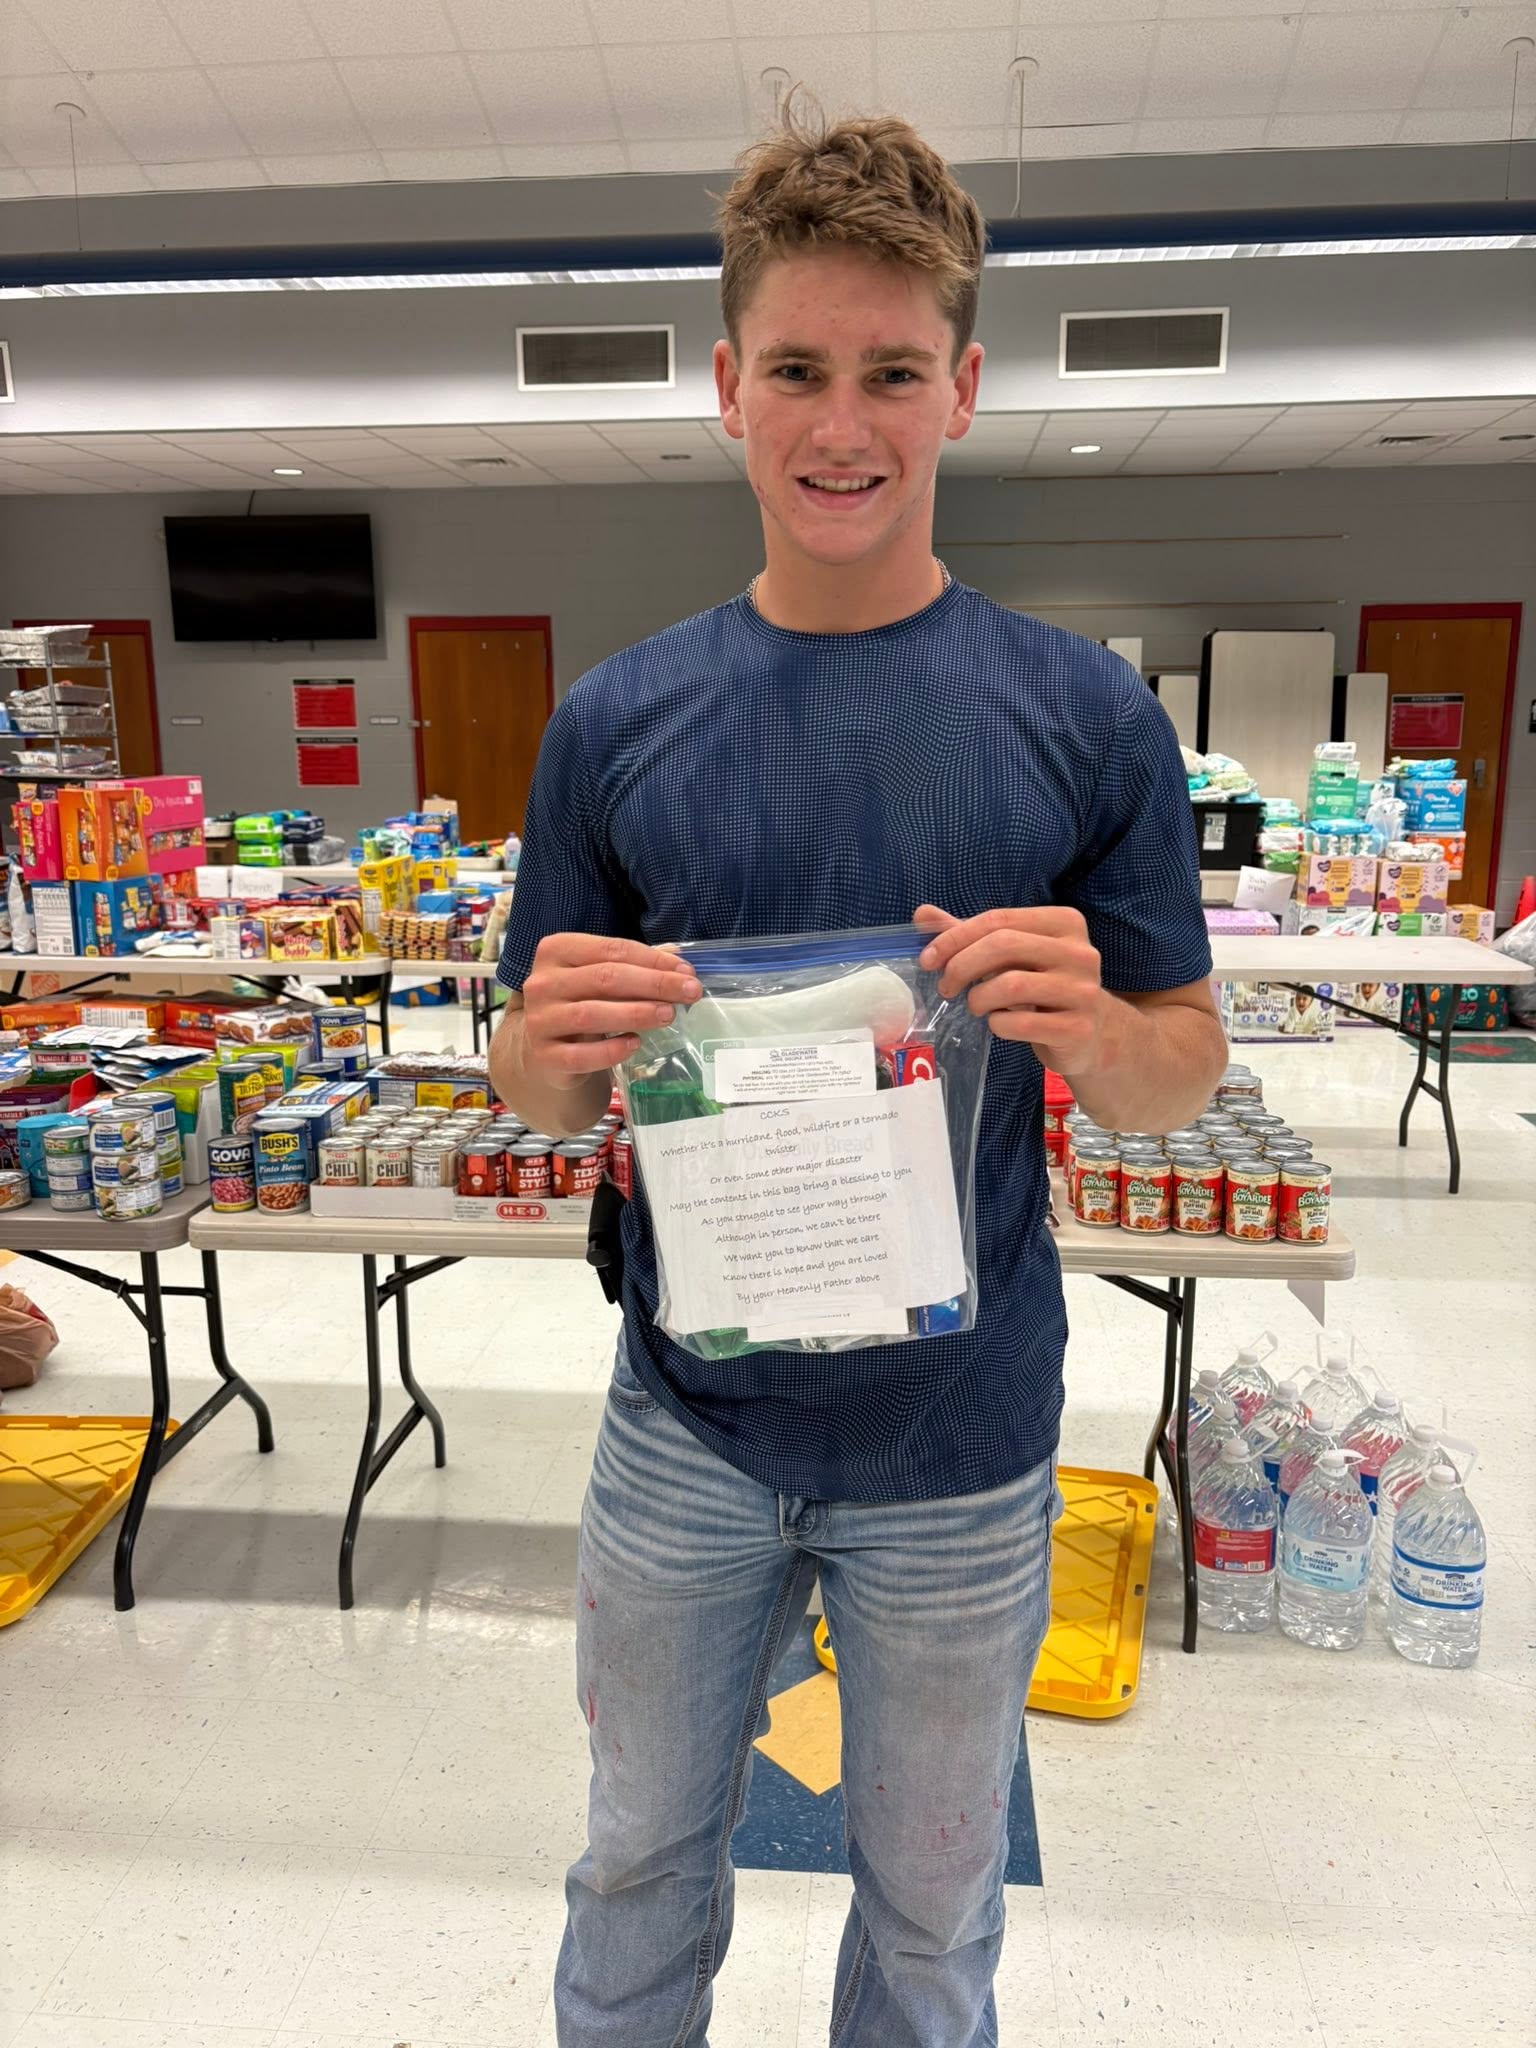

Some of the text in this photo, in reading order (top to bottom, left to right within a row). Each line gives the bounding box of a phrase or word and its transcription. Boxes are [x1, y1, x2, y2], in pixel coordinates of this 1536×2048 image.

[1261, 1002, 1289, 1013] Wipes
[660, 1144, 698, 1157] Whether
[700, 1140, 716, 1150] it's
[775, 1127, 801, 1139] flood,
[803, 1120, 841, 1133] wildfire
[842, 1119, 852, 1128] or
[854, 1117, 860, 1125] a
[862, 1110, 899, 1124] tornado
[261, 1136, 299, 1150] BUSH'S
[765, 1143, 798, 1156] twister
[211, 1147, 251, 1162] GOYA
[325, 1160, 358, 1177] CHILI
[377, 1160, 409, 1178] CHILI
[710, 1154, 863, 1185] Or even some other major disaster
[669, 1167, 913, 1213] May the contents in this bag bring a blessing to you
[1081, 1177, 1118, 1189] BOYARDEE
[1127, 1183, 1165, 1197] BOYARDEE
[1177, 1185, 1215, 1198] BOYARDEE
[1232, 1191, 1272, 1205] BOYARDEE
[700, 1191, 888, 1228] As you struggle to see your way through
[715, 1212, 881, 1244] Although in person, we can't be there
[723, 1233, 880, 1262] We want you to know that we care
[722, 1251, 889, 1283] Know there is hope and you are loved
[736, 1272, 881, 1304] By your Heavenly Father above
[1303, 1555, 1339, 1569] DRINKING
[1308, 1563, 1333, 1573] WATER
[1435, 1579, 1474, 1588] DRINKING
[1441, 1585, 1468, 1593] WATER
